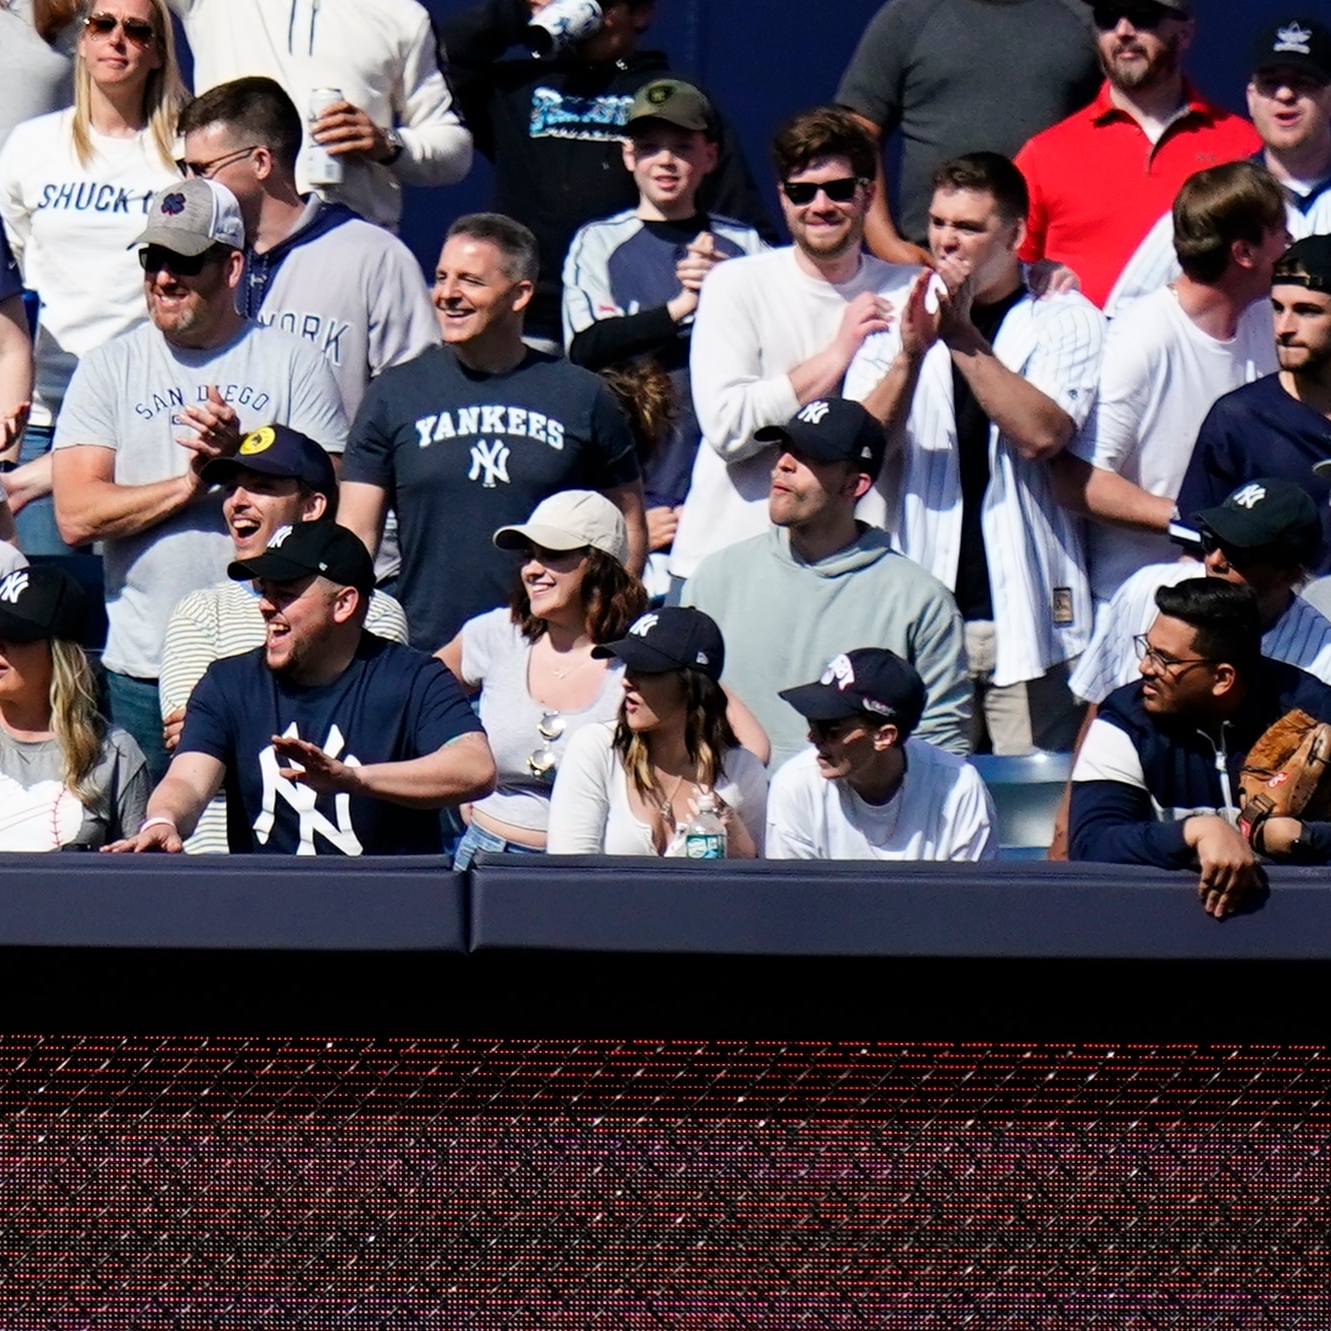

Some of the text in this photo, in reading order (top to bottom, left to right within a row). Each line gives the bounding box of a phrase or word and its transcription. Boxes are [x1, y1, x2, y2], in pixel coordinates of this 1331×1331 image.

[37, 182, 129, 214] SHUCK
[135, 386, 185, 421] SAN
[415, 404, 565, 450] YANKEES
